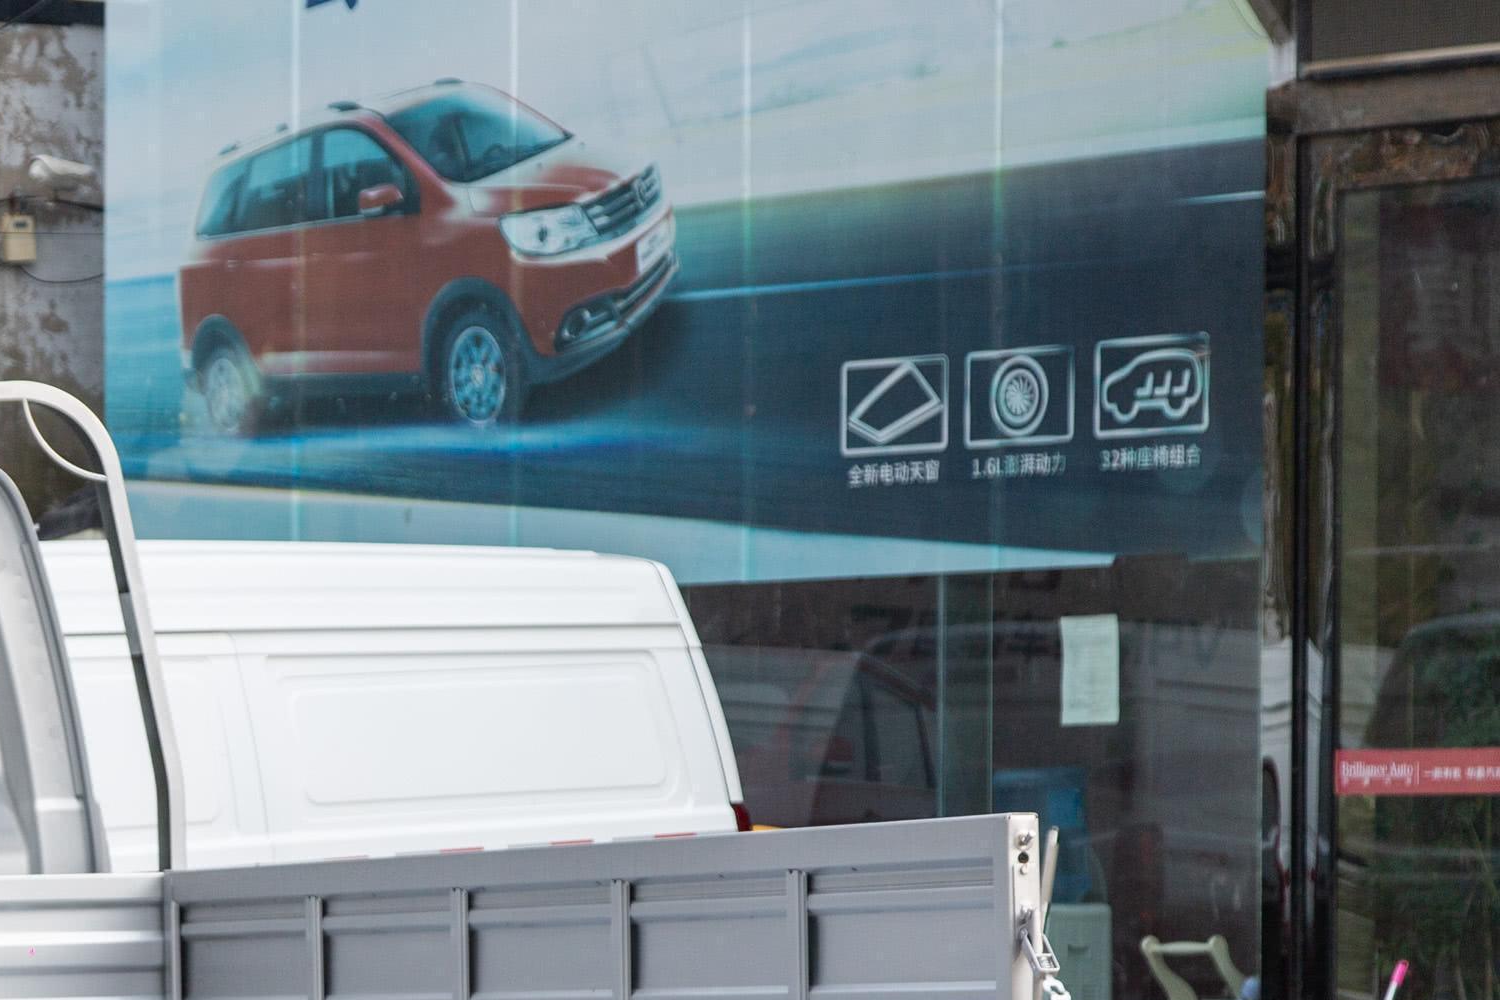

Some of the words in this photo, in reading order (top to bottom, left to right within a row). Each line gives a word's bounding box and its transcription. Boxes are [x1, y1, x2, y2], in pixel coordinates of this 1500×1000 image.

[971, 451, 1068, 480] 1.6L澎湃动力
[1101, 443, 1201, 472] 32种座椅组合
[848, 459, 941, 488] 全新电动天窗
